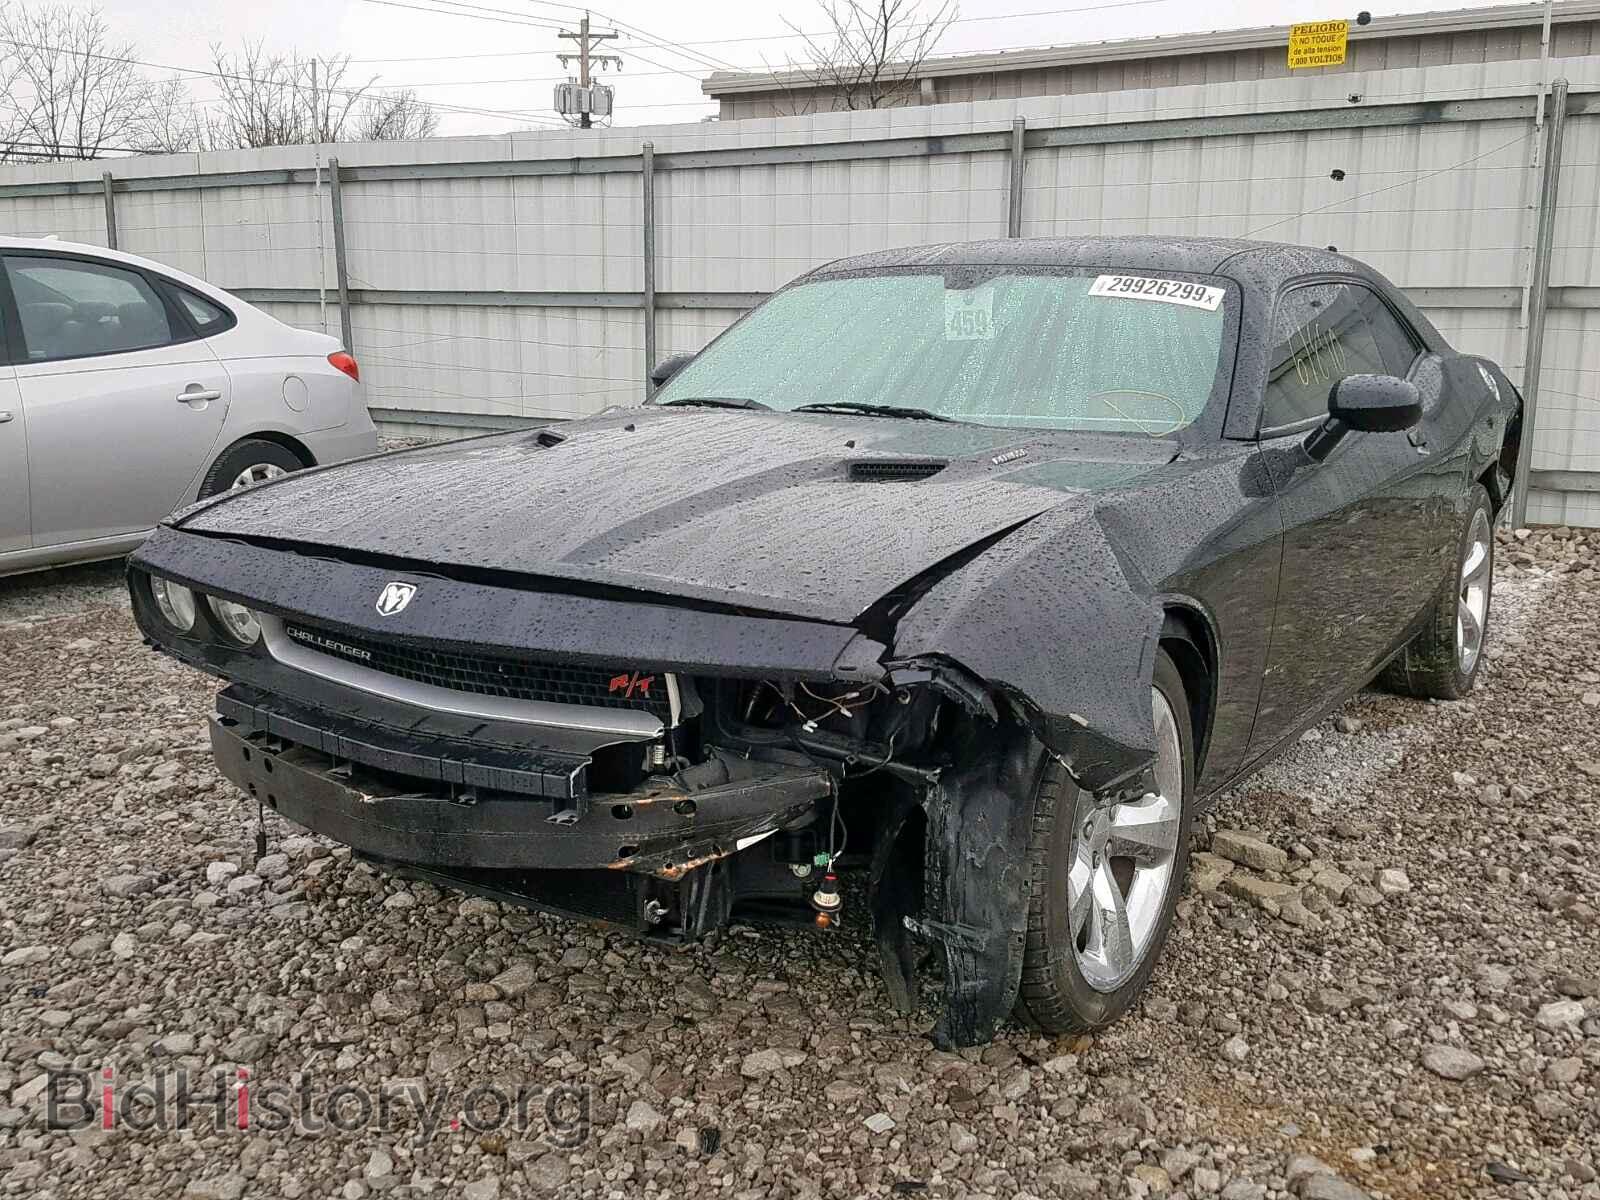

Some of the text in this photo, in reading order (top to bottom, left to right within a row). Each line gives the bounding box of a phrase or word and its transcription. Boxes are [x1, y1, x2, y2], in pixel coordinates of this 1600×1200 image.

[1294, 23, 1345, 34] PELIGRO
[1300, 37, 1310, 45] NO
[1309, 54, 1343, 63] VOLTIOS
[286, 626, 371, 660] CHALLENGER
[608, 671, 655, 698] R/T
